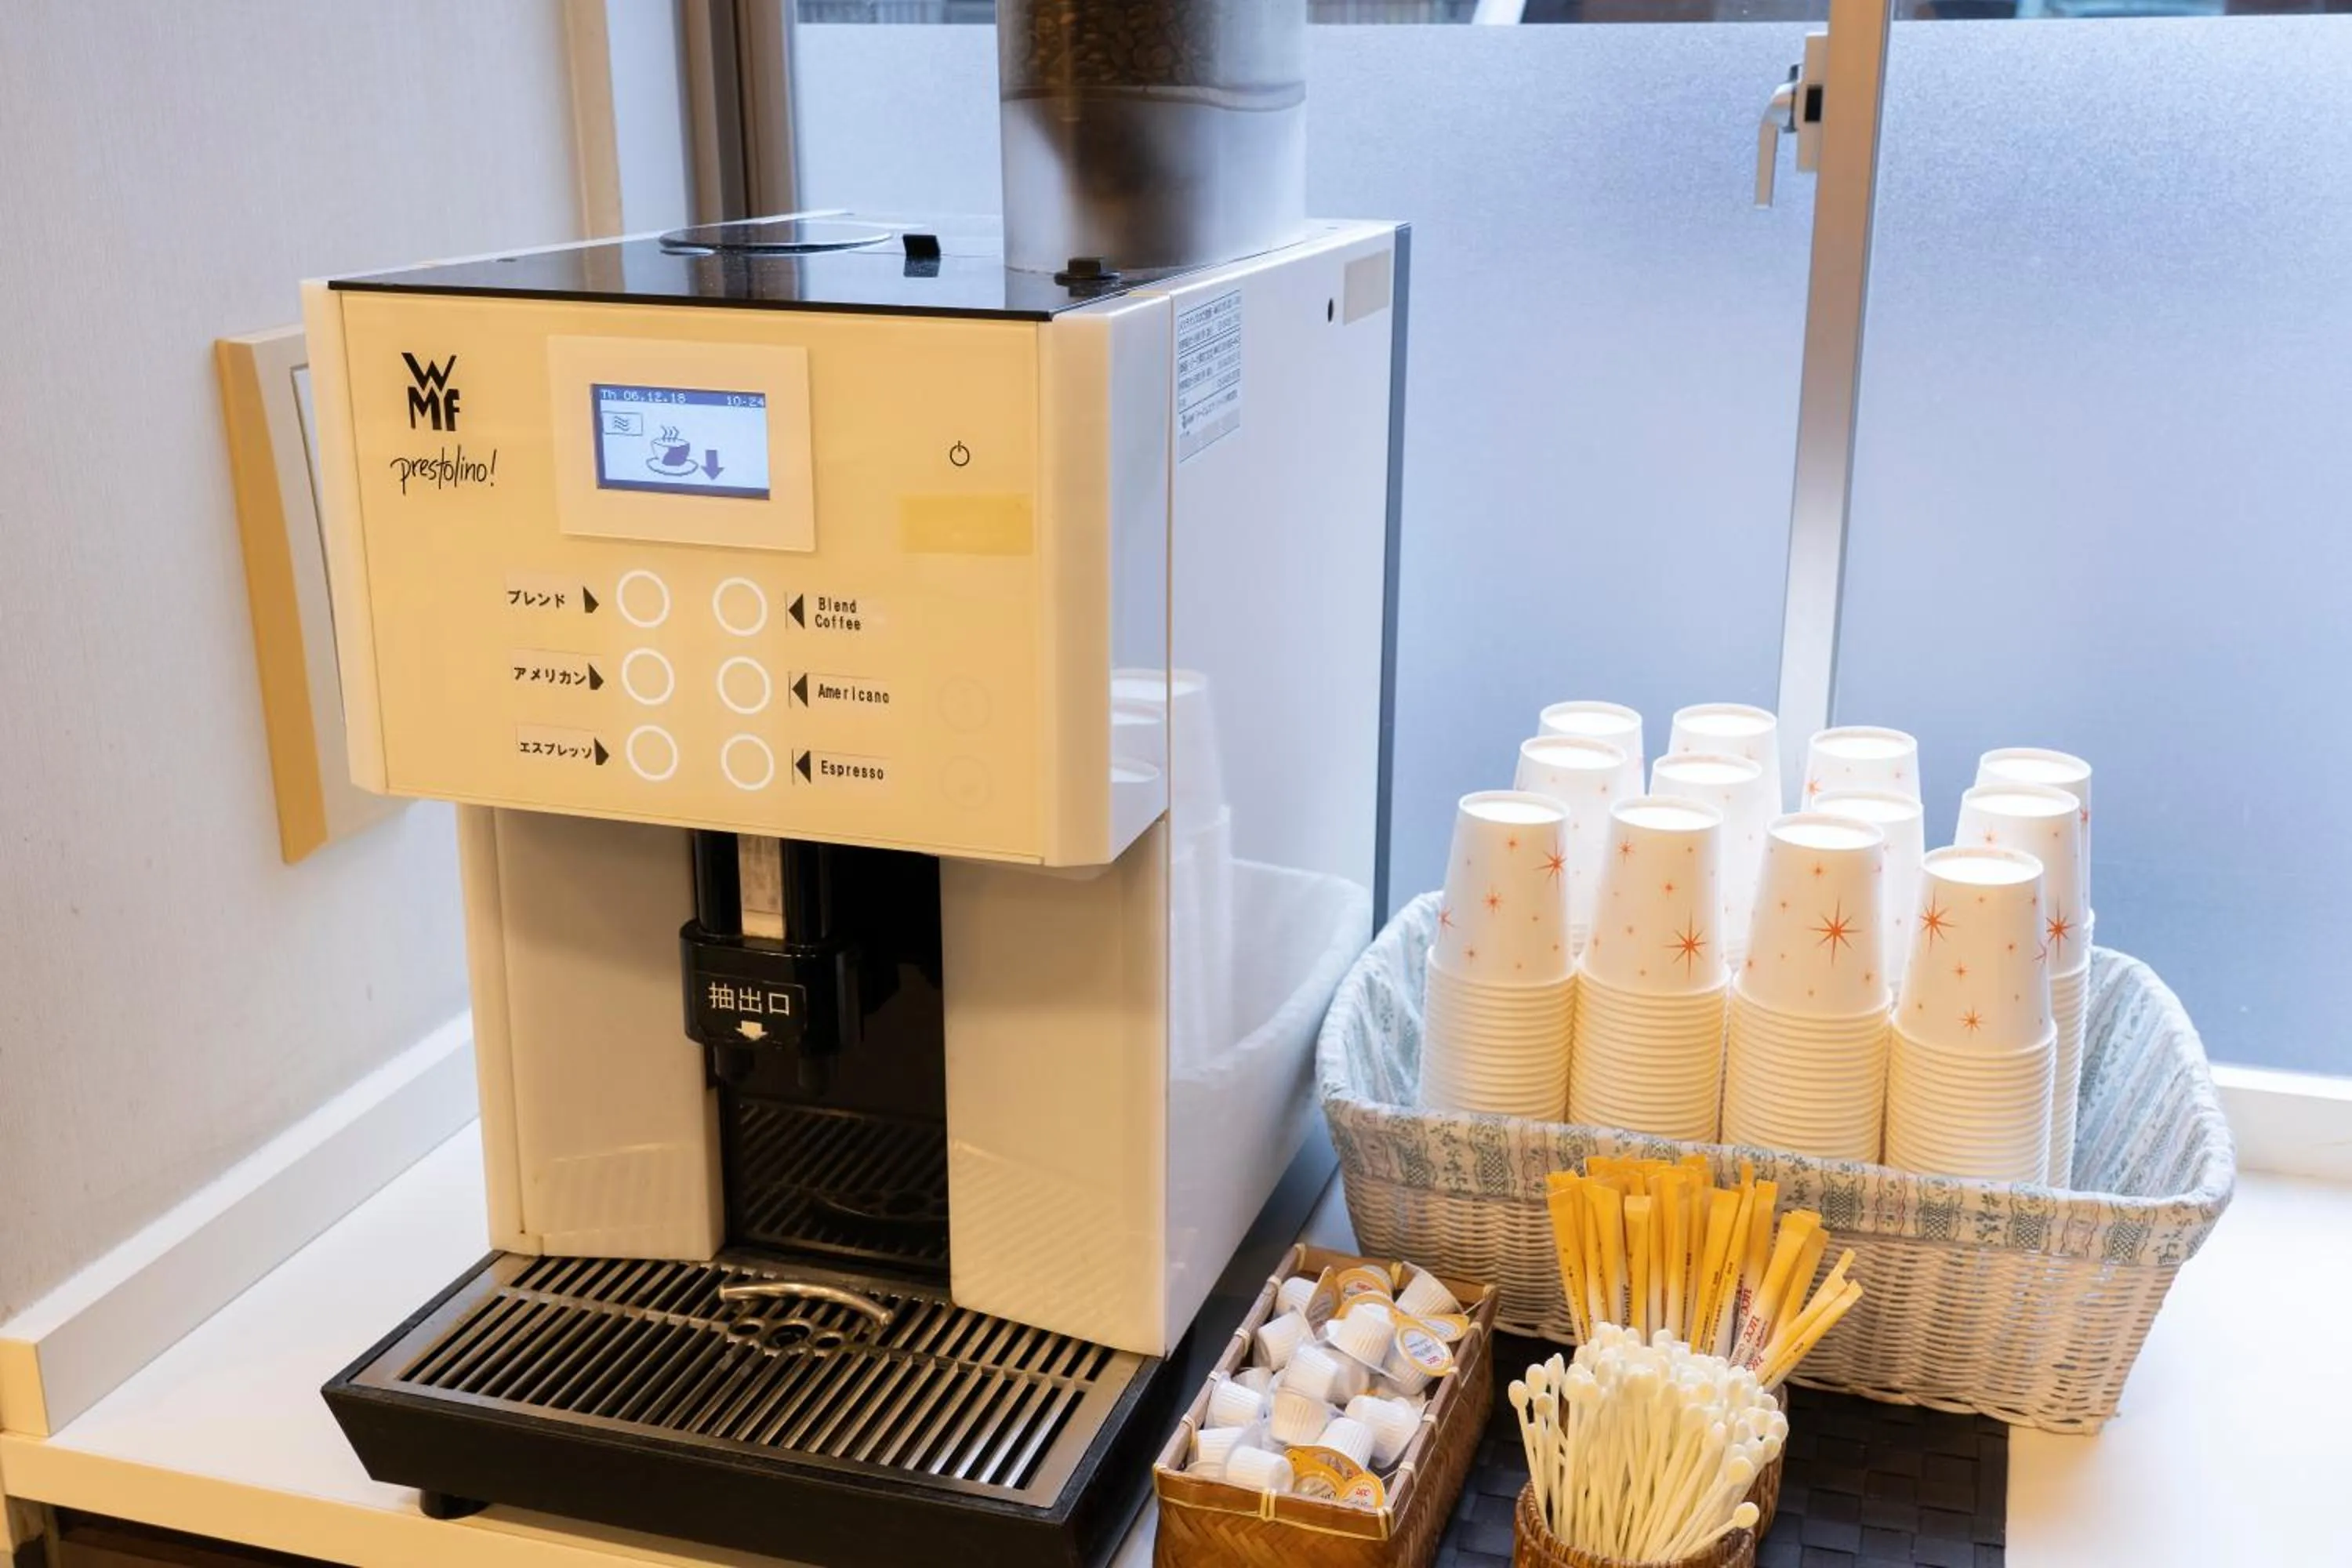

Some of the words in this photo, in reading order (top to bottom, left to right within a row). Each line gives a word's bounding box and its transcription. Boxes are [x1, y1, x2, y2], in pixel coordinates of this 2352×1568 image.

[623, 391, 687, 404] 06.12.18
[390, 444, 498, 496] prestolino!
[507, 590, 566, 609] ブレンド
[818, 597, 857, 613] Blend
[815, 614, 862, 630] Coffee
[514, 666, 587, 686] アメリカン
[817, 683, 891, 704] Americano
[820, 760, 884, 780] Espresso
[709, 981, 790, 1016] 抽出口
